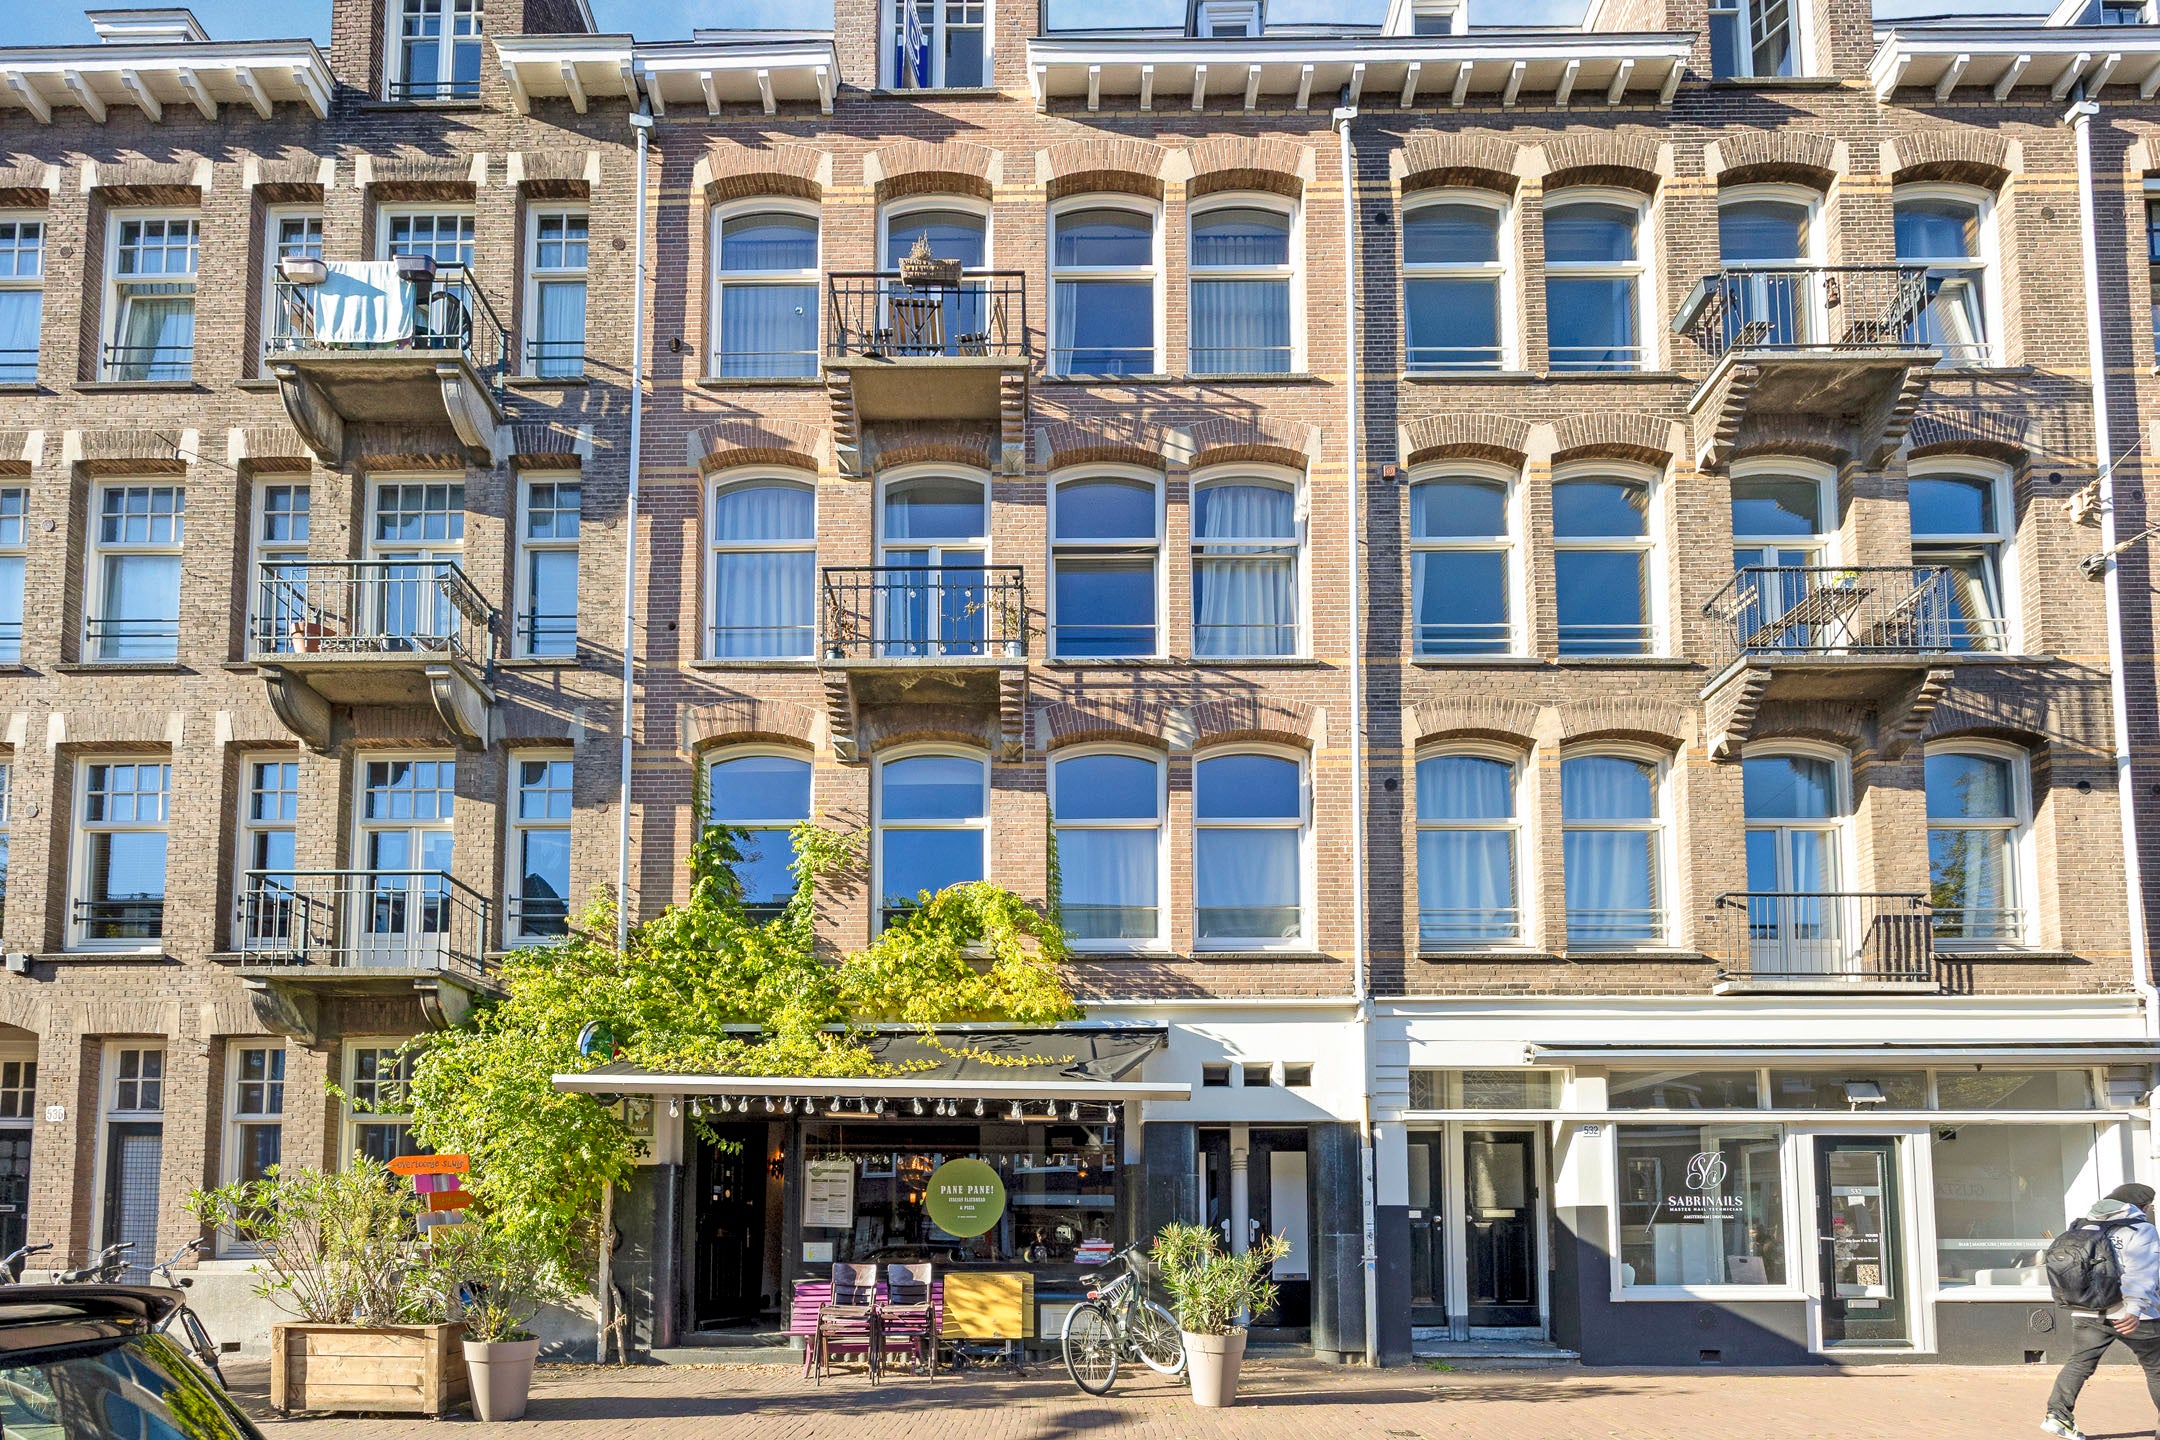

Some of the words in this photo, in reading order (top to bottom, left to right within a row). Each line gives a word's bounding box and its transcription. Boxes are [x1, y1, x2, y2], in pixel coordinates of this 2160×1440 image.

[1583, 1125, 1599, 1135] 532
[940, 1185, 963, 1195] PANE
[967, 1185, 994, 1195] PANE!
[1668, 1195, 1743, 1207] SABRINAILS
